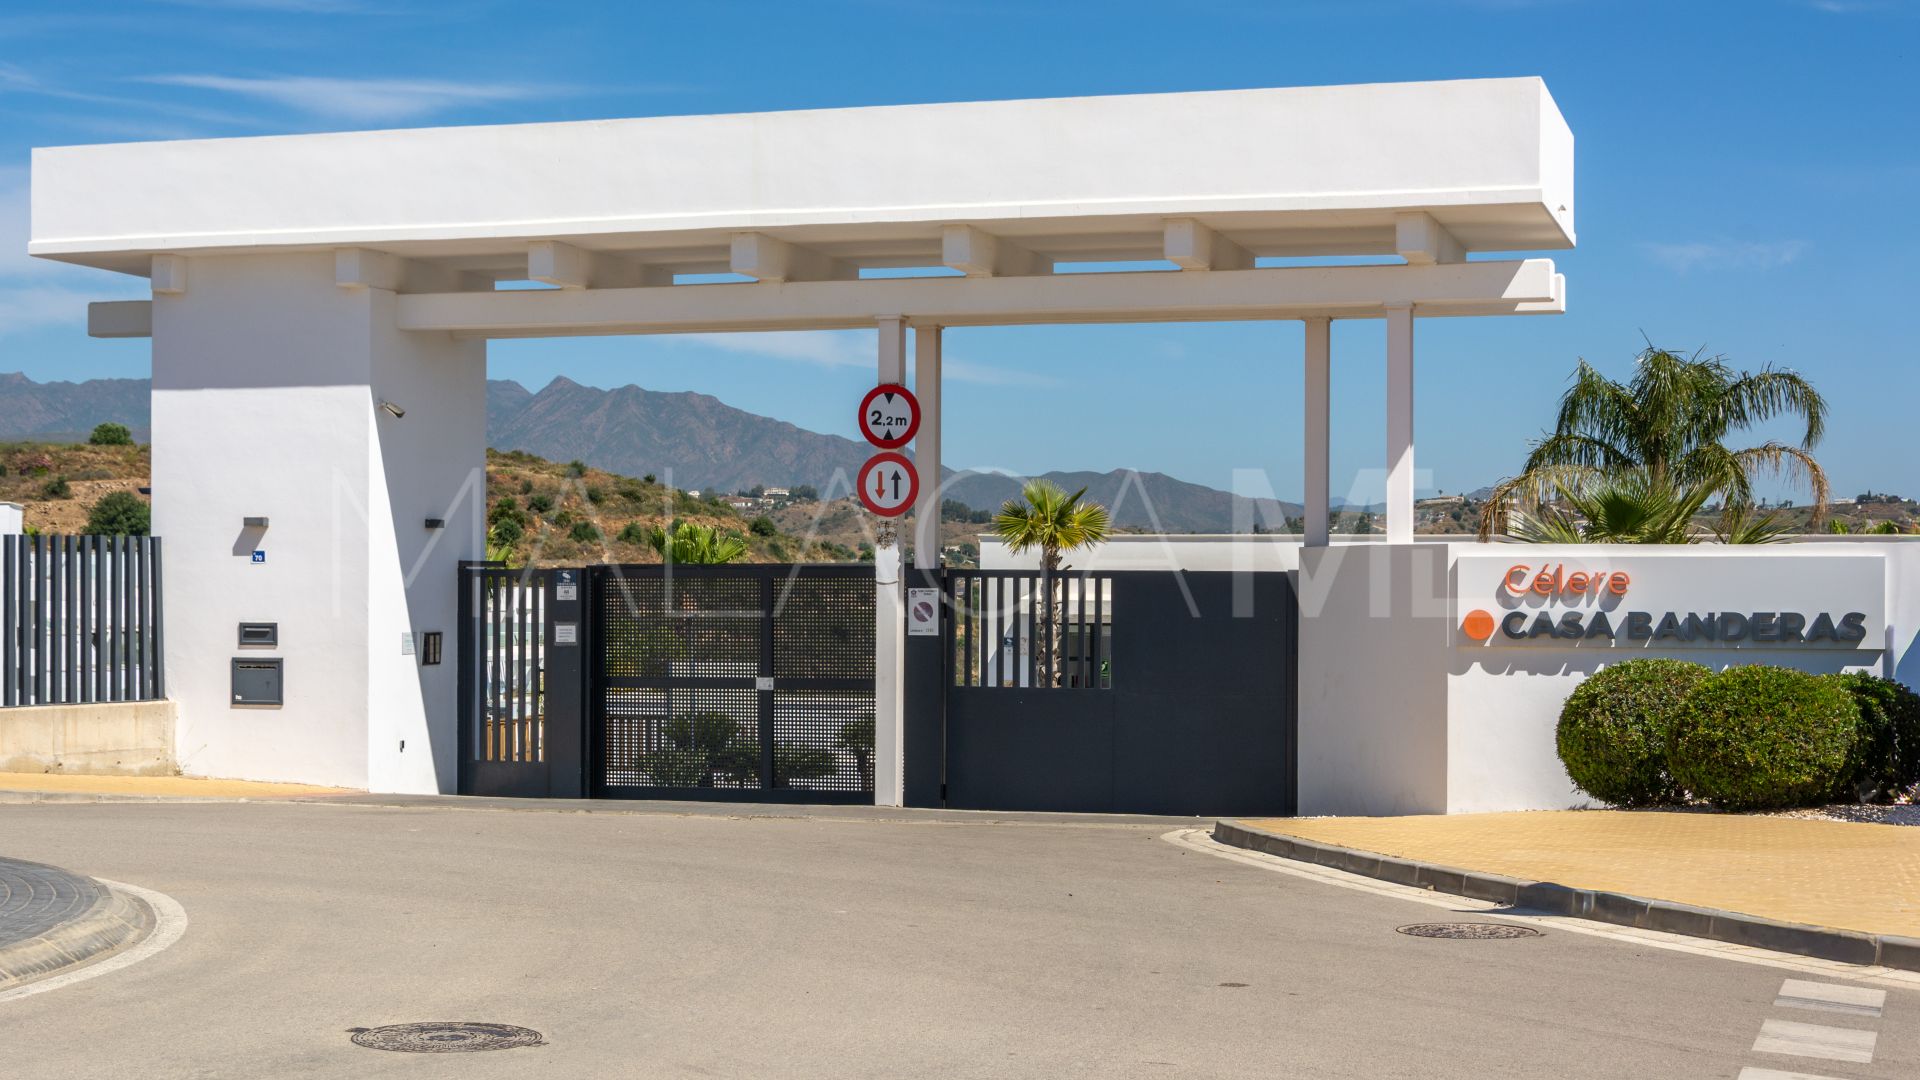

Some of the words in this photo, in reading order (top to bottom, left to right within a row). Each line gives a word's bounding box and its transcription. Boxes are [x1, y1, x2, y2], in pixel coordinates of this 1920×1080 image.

[1505, 563, 1630, 595] Célere
[1502, 611, 1615, 640] CASA
[1627, 611, 1867, 642] BANDERAS
